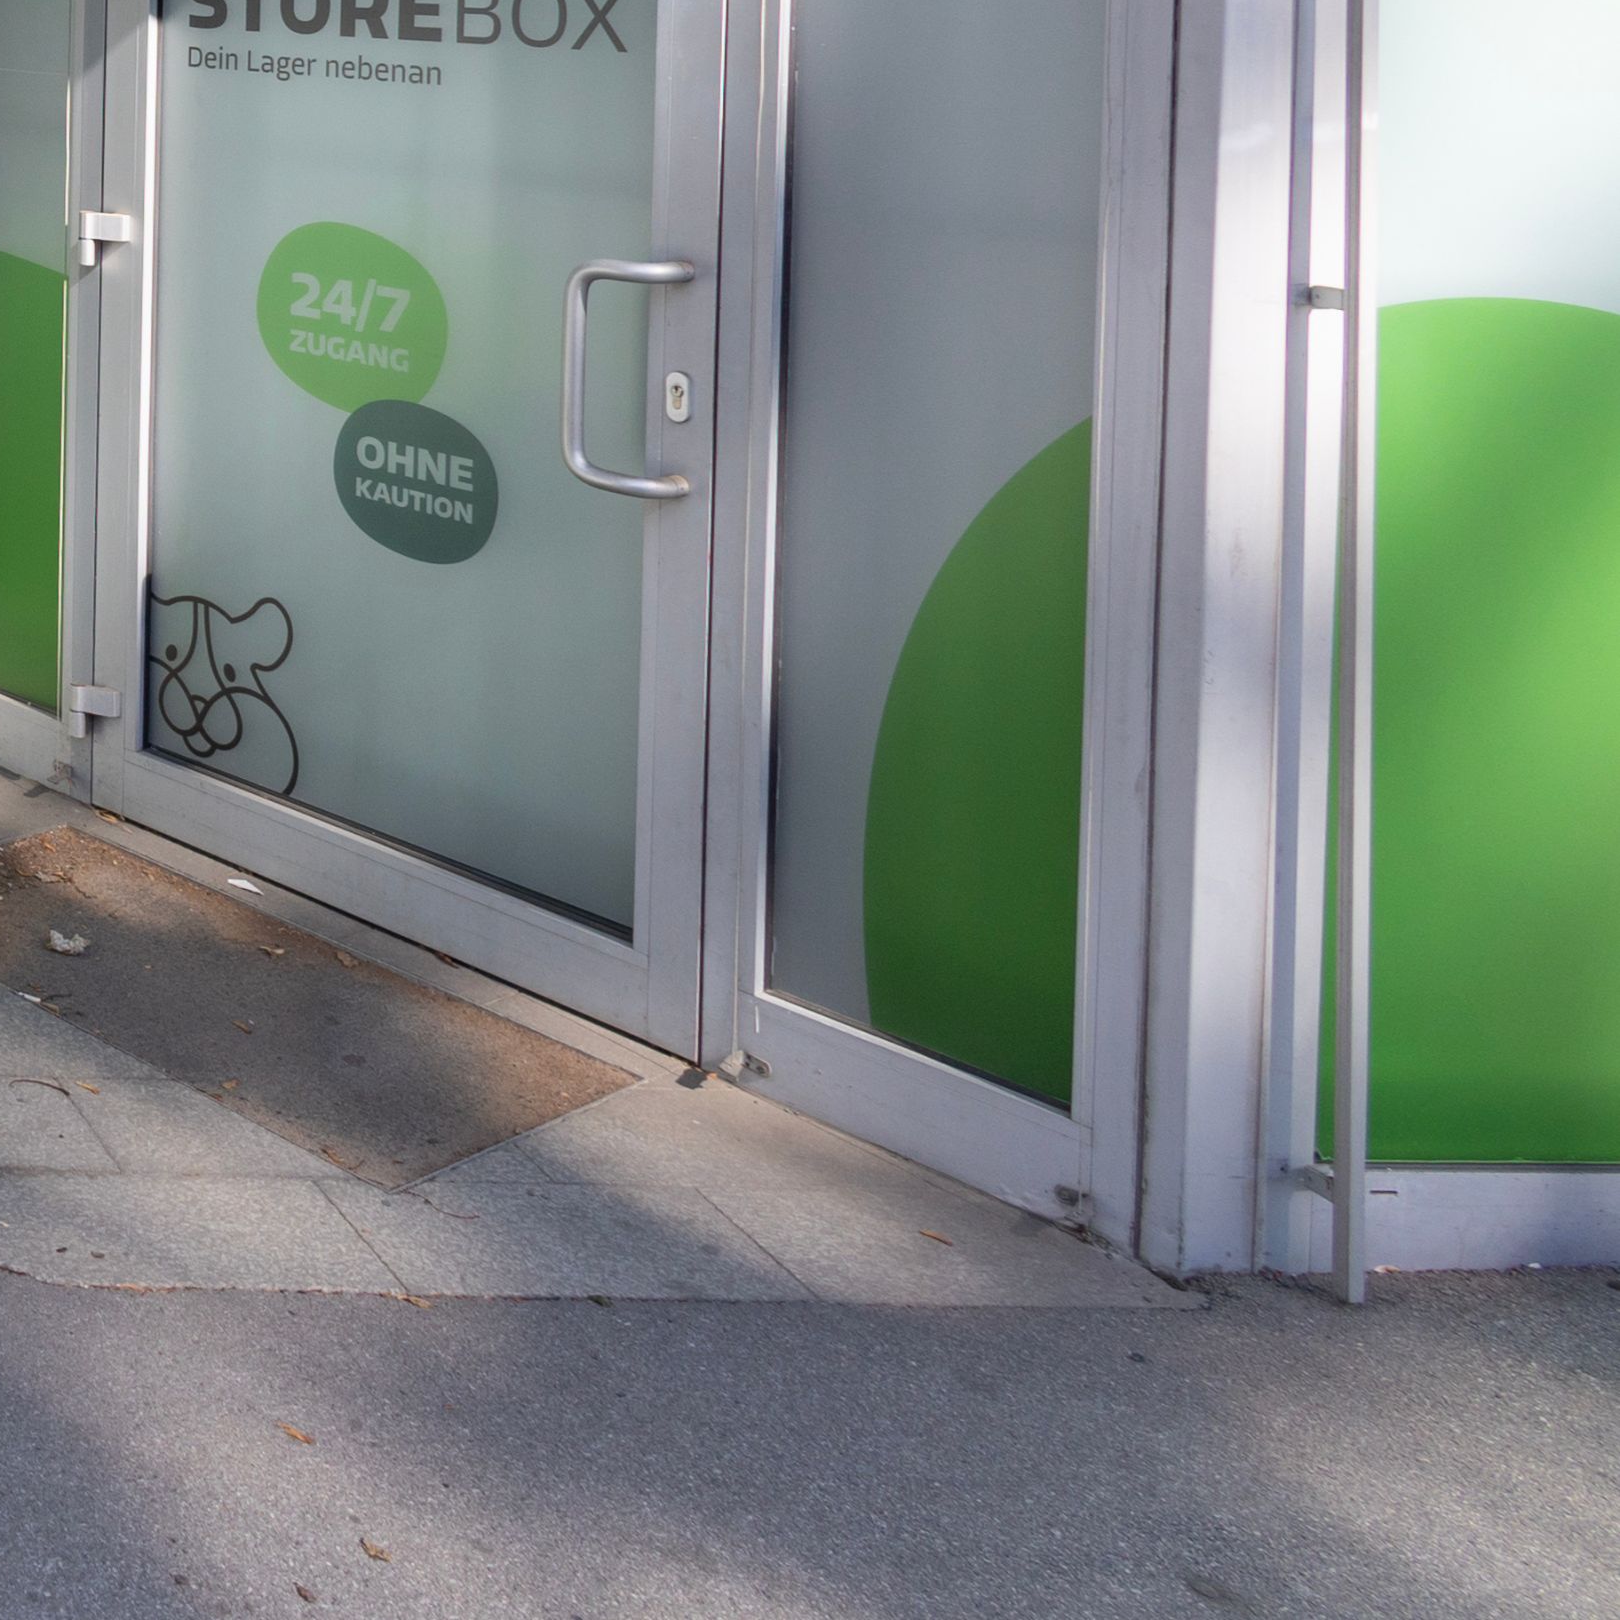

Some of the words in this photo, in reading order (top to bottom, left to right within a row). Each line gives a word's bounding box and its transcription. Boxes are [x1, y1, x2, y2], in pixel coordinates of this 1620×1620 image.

[188, 46, 238, 72] Dein
[247, 49, 317, 82] Lager
[325, 55, 442, 86] nebenan
[289, 272, 411, 333] 24/7
[288, 328, 410, 373] ZUGANG
[356, 435, 474, 492] OHNE
[355, 476, 474, 525] KAUTION
